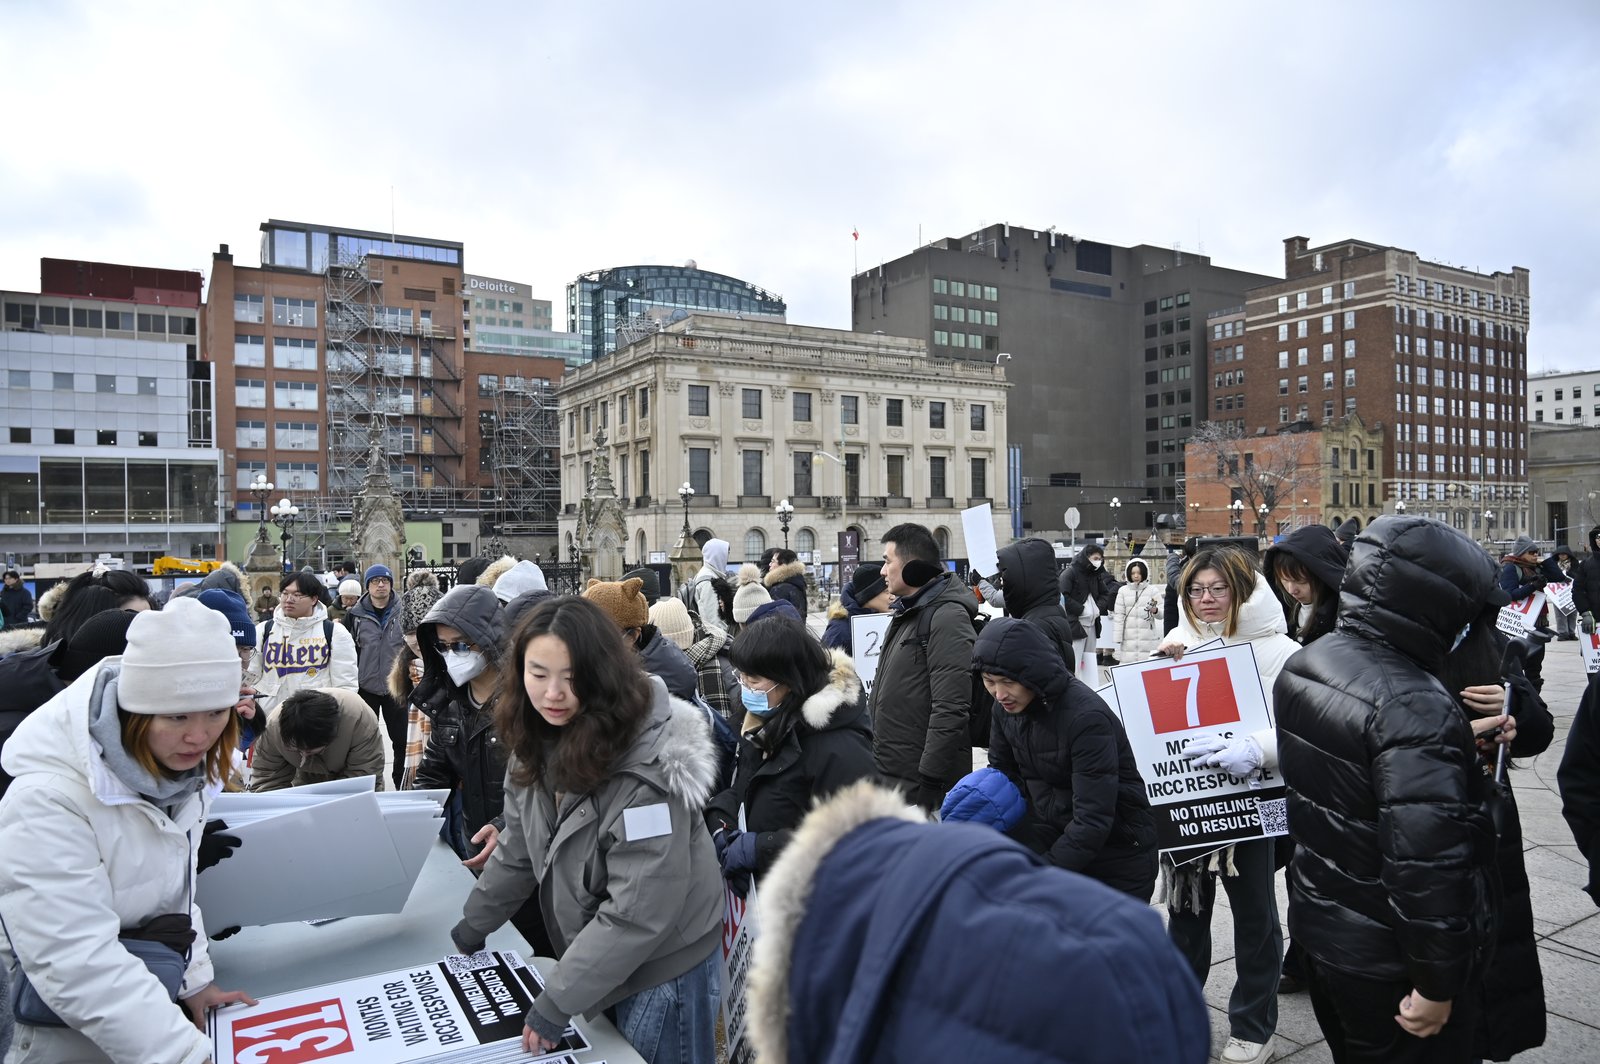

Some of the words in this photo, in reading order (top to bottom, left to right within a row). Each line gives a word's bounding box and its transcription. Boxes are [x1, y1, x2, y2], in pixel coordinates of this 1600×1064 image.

[470, 278, 516, 294] Deloitte
[1170, 664, 1200, 727] 7
[1148, 778, 1184, 798] IRCC
[1186, 768, 1274, 793] RESPOE
[1170, 807, 1189, 822] NO
[1191, 796, 1262, 819] TIMELINES
[1179, 822, 1199, 837] NO
[1202, 814, 1261, 834] RESULTS
[383, 980, 410, 1001] FOR
[409, 970, 452, 1021] RESPONSE
[454, 971, 492, 1013] TIMELINES
[478, 969, 514, 1004] RESULTS
[356, 996, 392, 1042] MONTHS
[388, 1000, 429, 1047] WAITING
[476, 1010, 500, 1026] NO
[498, 1002, 522, 1017] NO
[235, 1003, 349, 1064] 31
[432, 1018, 464, 1046] IRCC
